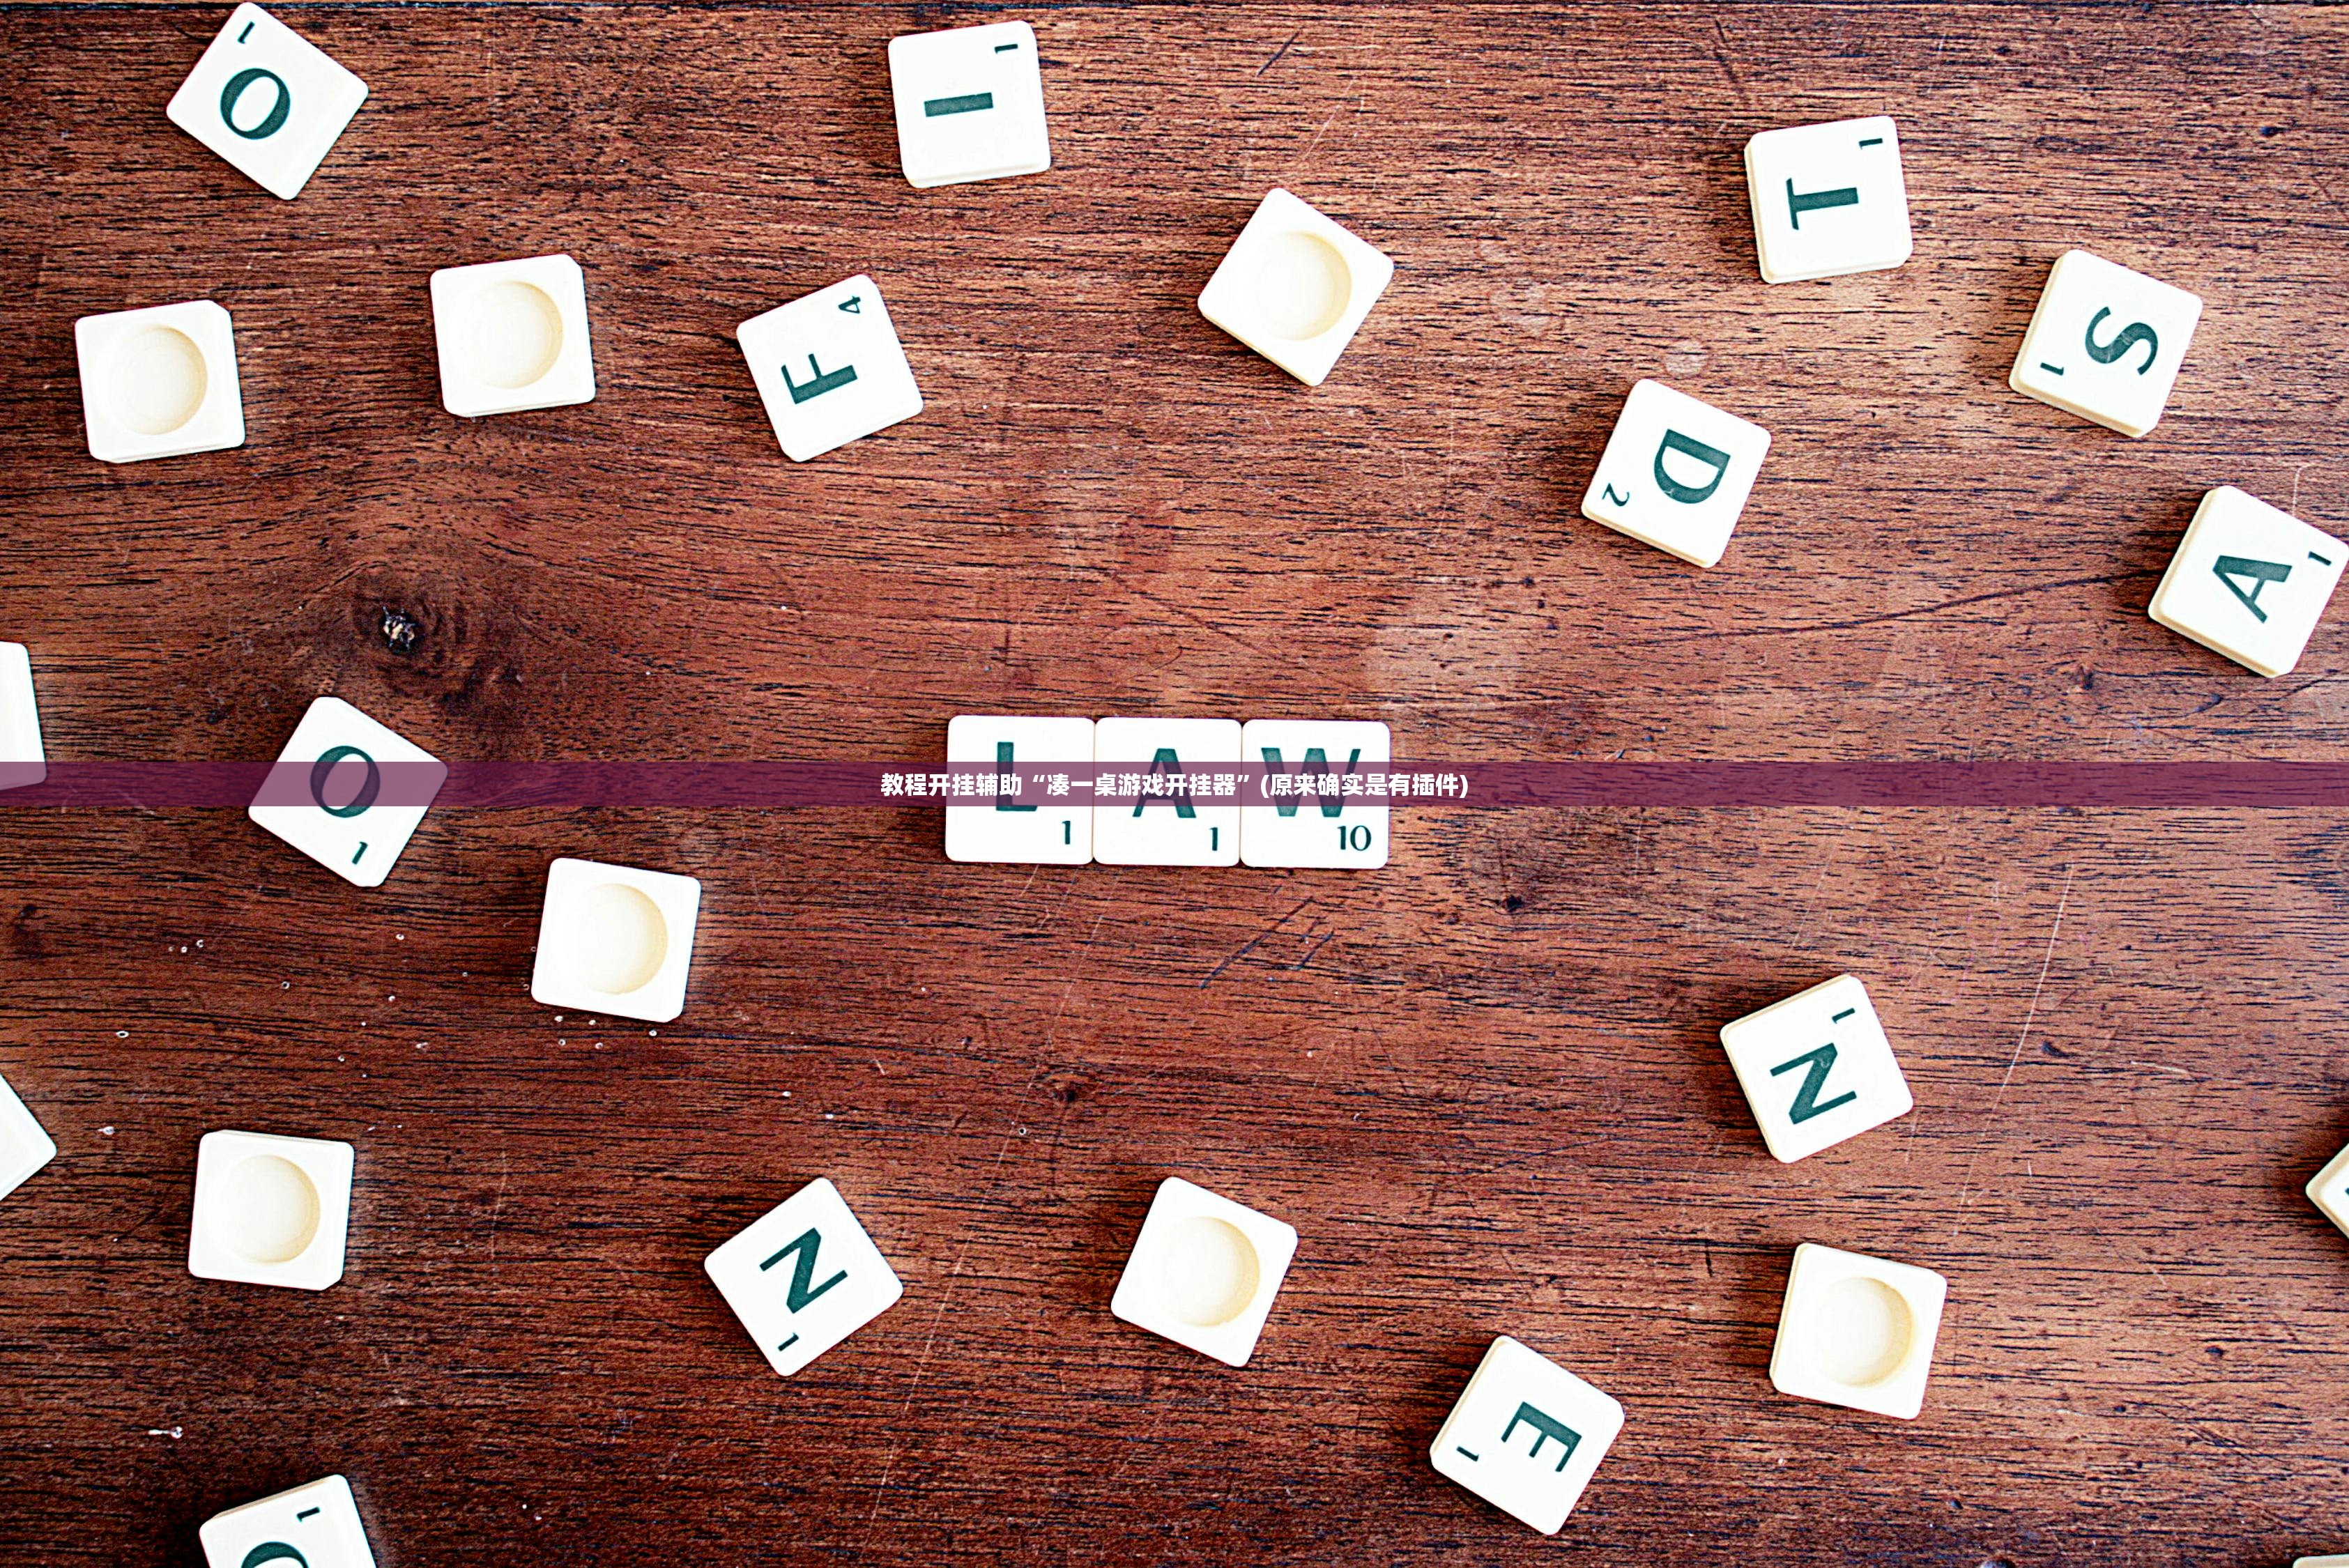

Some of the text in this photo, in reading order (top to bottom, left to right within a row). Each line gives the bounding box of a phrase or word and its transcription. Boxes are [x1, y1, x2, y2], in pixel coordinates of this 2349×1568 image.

[238, 21, 256, 45] 1
[994, 43, 1019, 54] 1
[219, 68, 291, 141] O
[924, 92, 995, 117] I
[1858, 137, 1884, 149] 1
[1786, 178, 1860, 231] T
[838, 295, 862, 315] 4
[2085, 307, 2159, 376] S
[781, 353, 858, 405] F
[2039, 362, 2065, 377] 1
[1653, 429, 1731, 505] D
[1602, 483, 1631, 507] 2
[2307, 551, 2333, 567] 1
[2212, 555, 2293, 624] A
[309, 744, 381, 819] O
[1062, 820, 1072, 846] 1
[1209, 827, 1219, 852] 1
[1337, 825, 1372, 852] 10
[351, 841, 369, 866] 1
[1831, 1008, 1856, 1024] 1
[1768, 1042, 1858, 1125] N
[759, 1227, 849, 1314] N
[777, 1332, 800, 1353] 1
[1500, 1401, 1583, 1473] E
[1456, 1446, 1480, 1463] 1
[296, 1507, 321, 1523] 1
